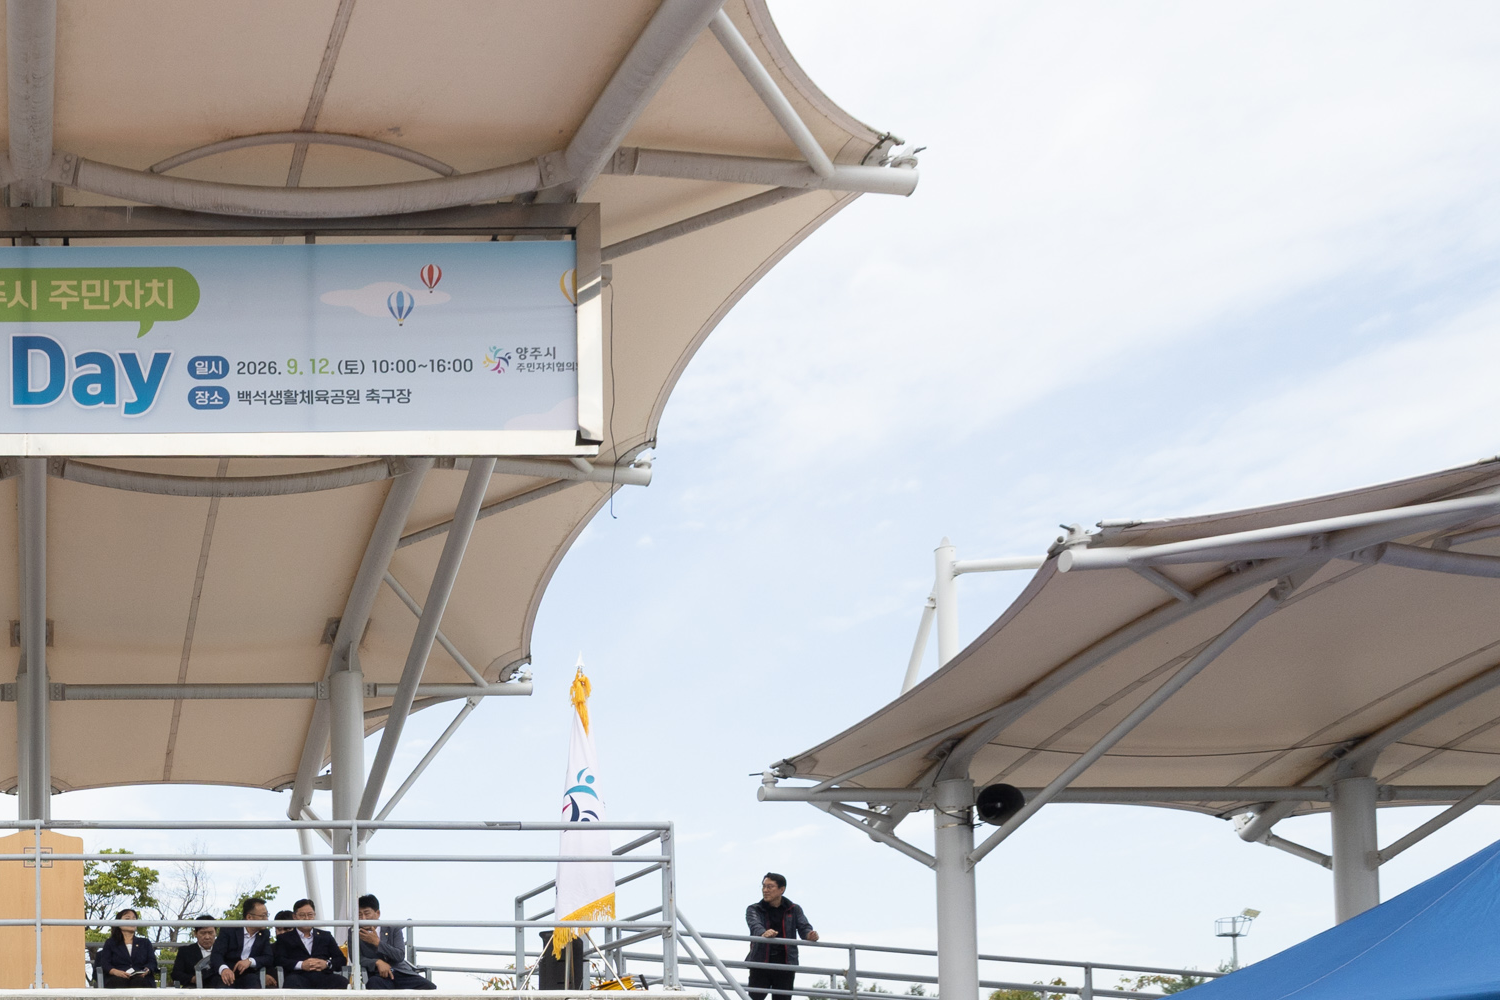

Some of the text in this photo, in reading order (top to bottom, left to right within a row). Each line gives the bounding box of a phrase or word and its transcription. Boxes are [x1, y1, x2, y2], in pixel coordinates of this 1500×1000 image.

[49, 278, 174, 310] 주민자치
[515, 346, 557, 360] 양주시
[11, 335, 172, 415] Day
[194, 359, 223, 376] 일시
[237, 361, 282, 375] 2026.
[372, 358, 474, 373] 10:00~16:00
[194, 389, 412, 406] 장소 백석생활체육공원 축구장
